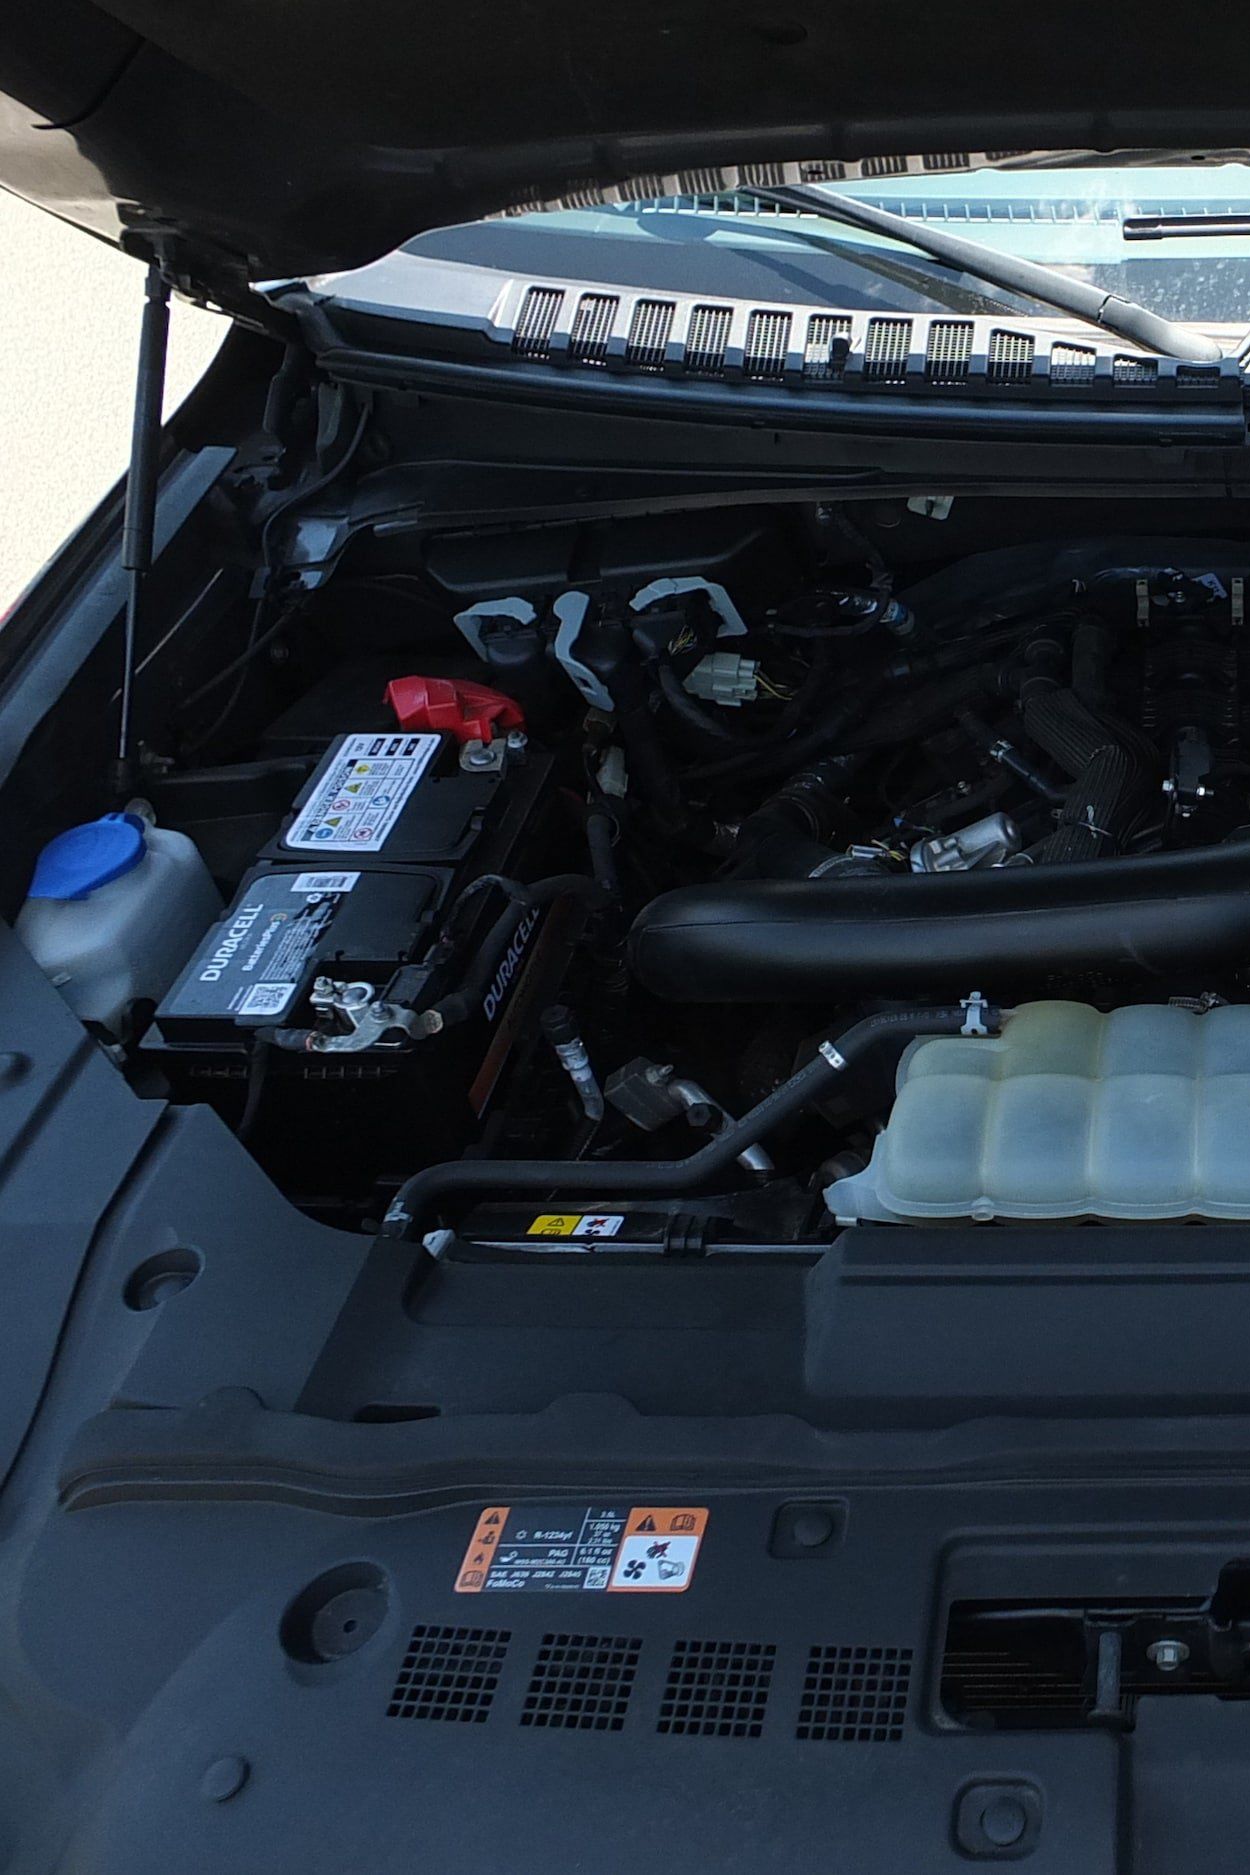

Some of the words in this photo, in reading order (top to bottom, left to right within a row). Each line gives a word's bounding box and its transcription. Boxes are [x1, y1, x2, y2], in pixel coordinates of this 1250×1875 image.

[199, 903, 264, 982] DURACELL
[610, 1523, 621, 1533] kg
[547, 1549, 569, 1557] PAG
[485, 1579, 526, 1588] FoMoCo
